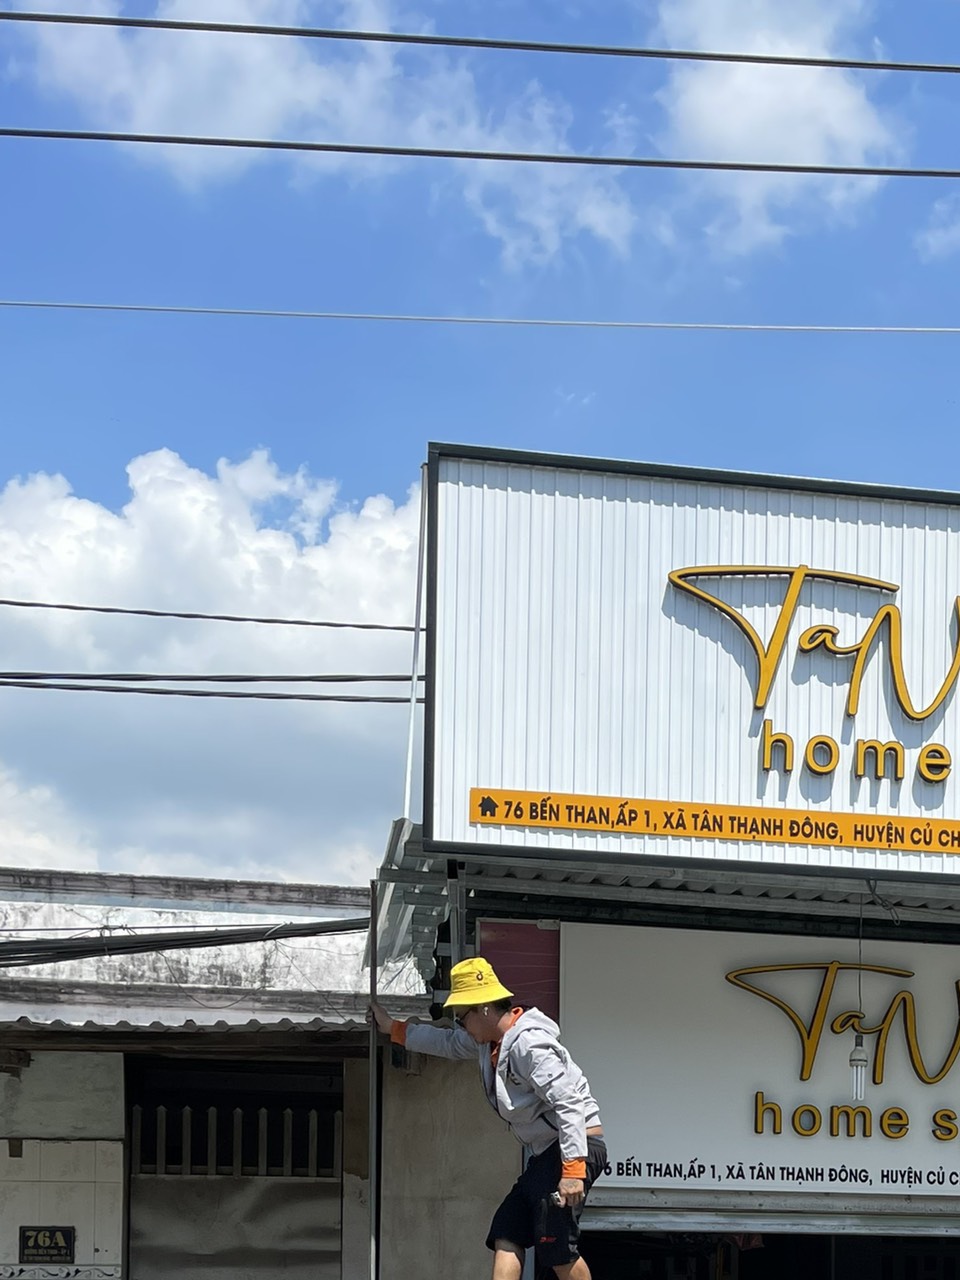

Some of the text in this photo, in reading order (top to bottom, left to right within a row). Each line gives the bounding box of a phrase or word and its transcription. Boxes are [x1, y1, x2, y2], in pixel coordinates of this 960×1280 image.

[762, 719, 952, 784] home
[504, 801, 524, 819] 76
[529, 796, 560, 822] BẾN
[663, 808, 687, 831] XÃ
[692, 809, 723, 834] TÂN
[729, 815, 784, 839] THẠNH
[789, 816, 843, 844] ĐÔNG,
[853, 821, 905, 848] HUYỆN
[910, 823, 933, 846] CỦ
[754, 1091, 910, 1140] home
[616, 1156, 642, 1177] BẾN
[726, 1162, 746, 1180] XÃ
[749, 1162, 775, 1181] TÂN
[780, 1166, 824, 1185] THẠNH
[828, 1164, 873, 1186] ĐÔNG,
[880, 1166, 922, 1188] HUYỆN
[926, 1166, 945, 1185] CỦ
[25, 1230, 67, 1247] 76A
